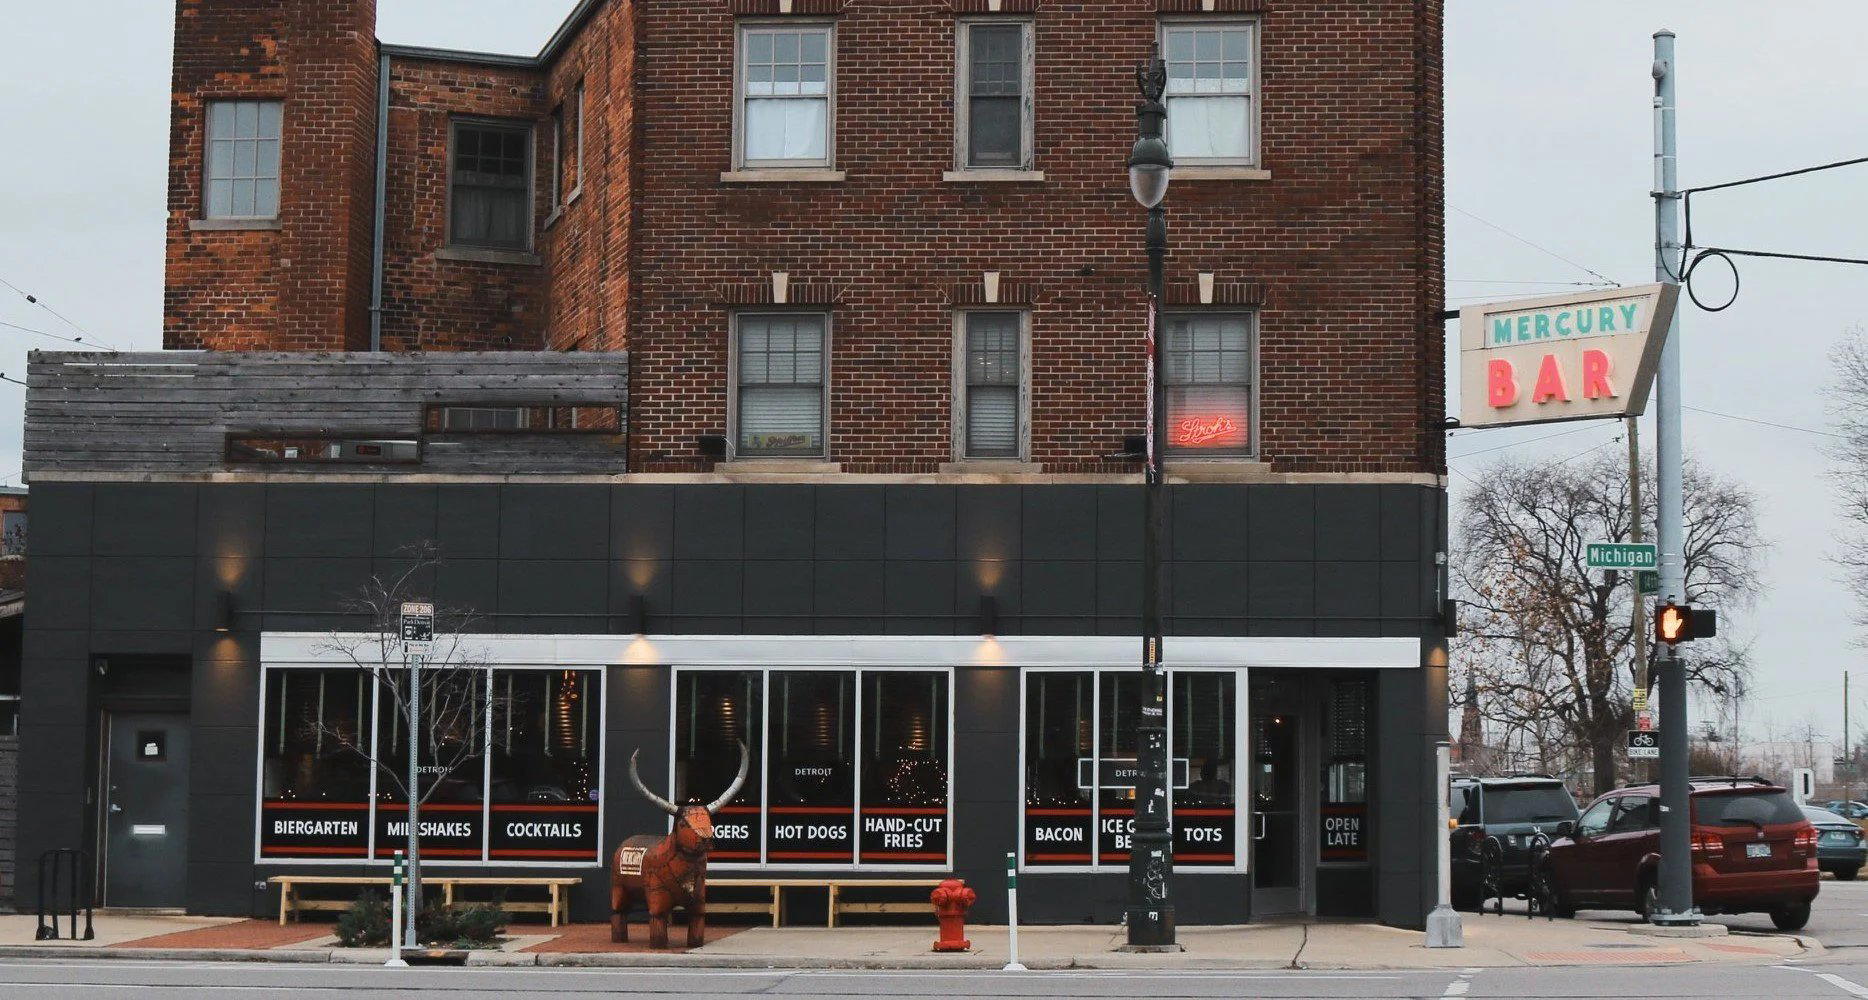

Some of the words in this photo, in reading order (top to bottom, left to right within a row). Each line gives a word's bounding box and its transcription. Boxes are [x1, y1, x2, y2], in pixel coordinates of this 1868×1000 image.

[1494, 303, 1637, 344] MERCURY
[1488, 349, 1618, 408] BAR
[1590, 547, 1652, 565] Michigan
[795, 767, 832, 777] DETROIT
[1115, 769, 1138, 777] DETR
[274, 820, 358, 836] BIERGARTEN
[387, 821, 472, 837] MILSHAKES
[506, 822, 582, 838] COCKTAILS
[865, 817, 943, 833] HAND-CUT
[1102, 819, 1123, 833] ICE
[1325, 817, 1359, 831] OPEN
[775, 825, 804, 839] HOT
[807, 825, 847, 840] DOGS
[1035, 827, 1083, 842] BACON
[1184, 827, 1223, 842] TOTS
[1328, 832, 1357, 845] LATE
[884, 833, 923, 848] FRIES
